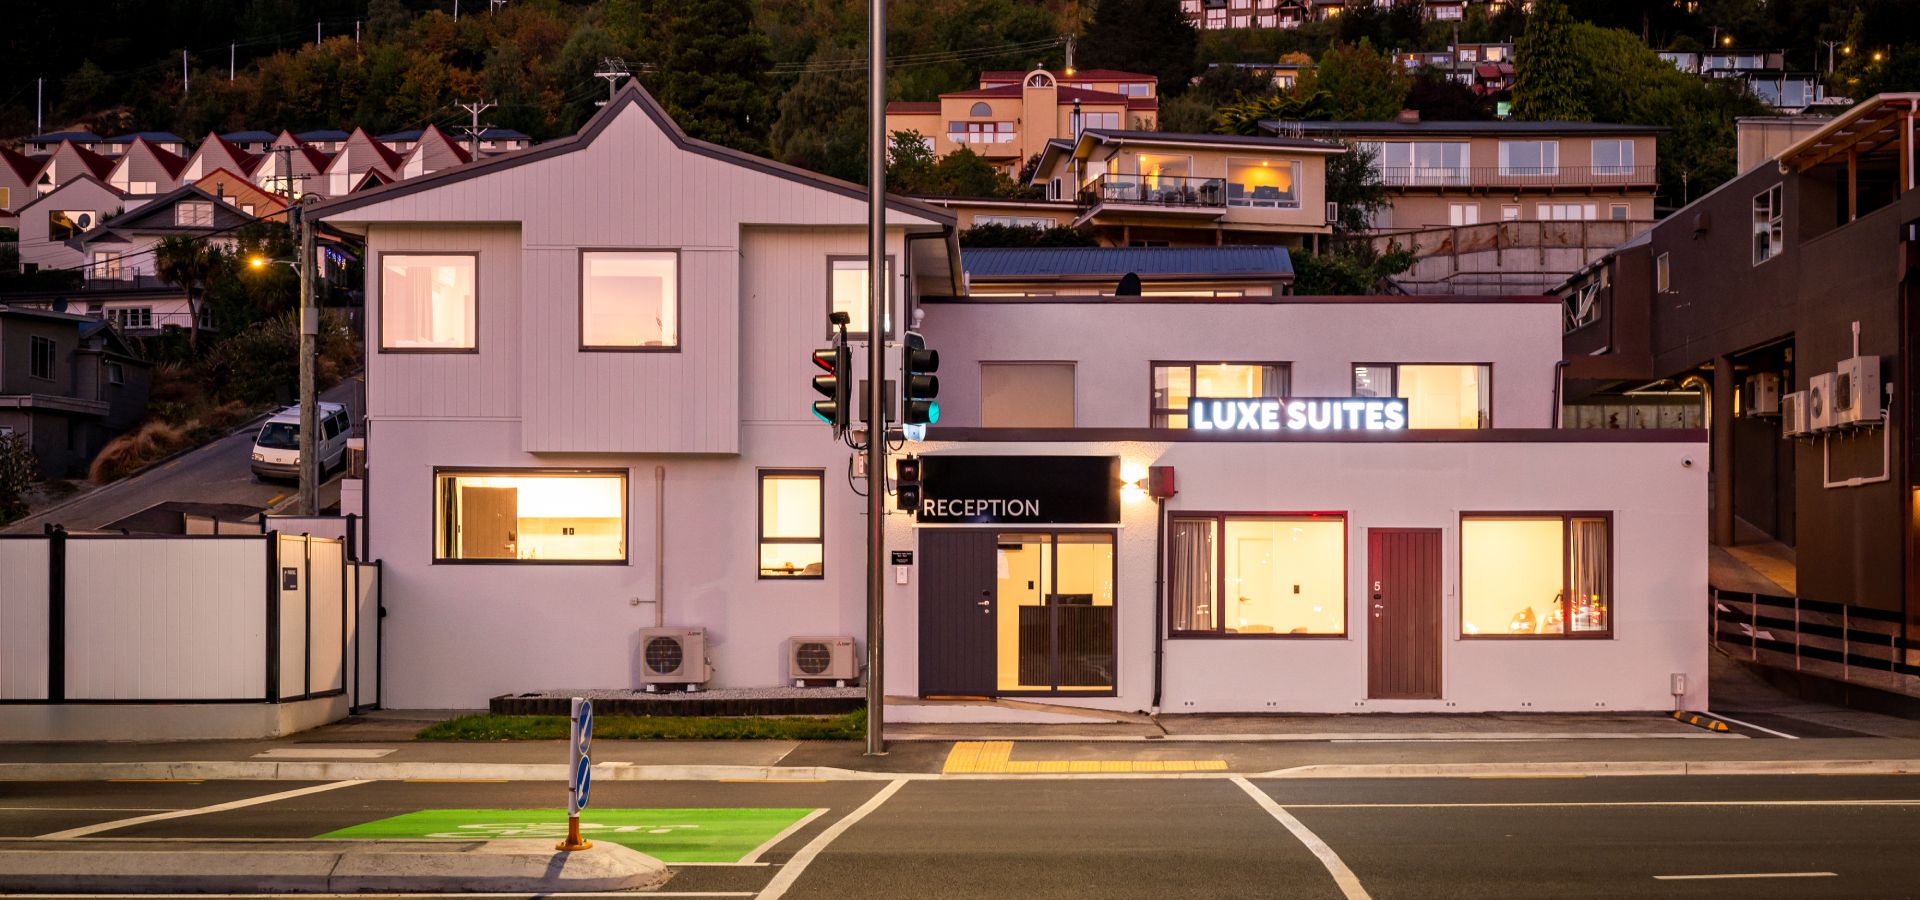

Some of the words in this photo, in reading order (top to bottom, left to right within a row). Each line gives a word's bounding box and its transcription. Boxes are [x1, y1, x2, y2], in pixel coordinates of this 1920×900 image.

[1194, 401, 1280, 430] LUXE
[1287, 401, 1404, 430] SUITES
[923, 499, 1039, 516] RECEPTION
[1374, 580, 1381, 591] 5
